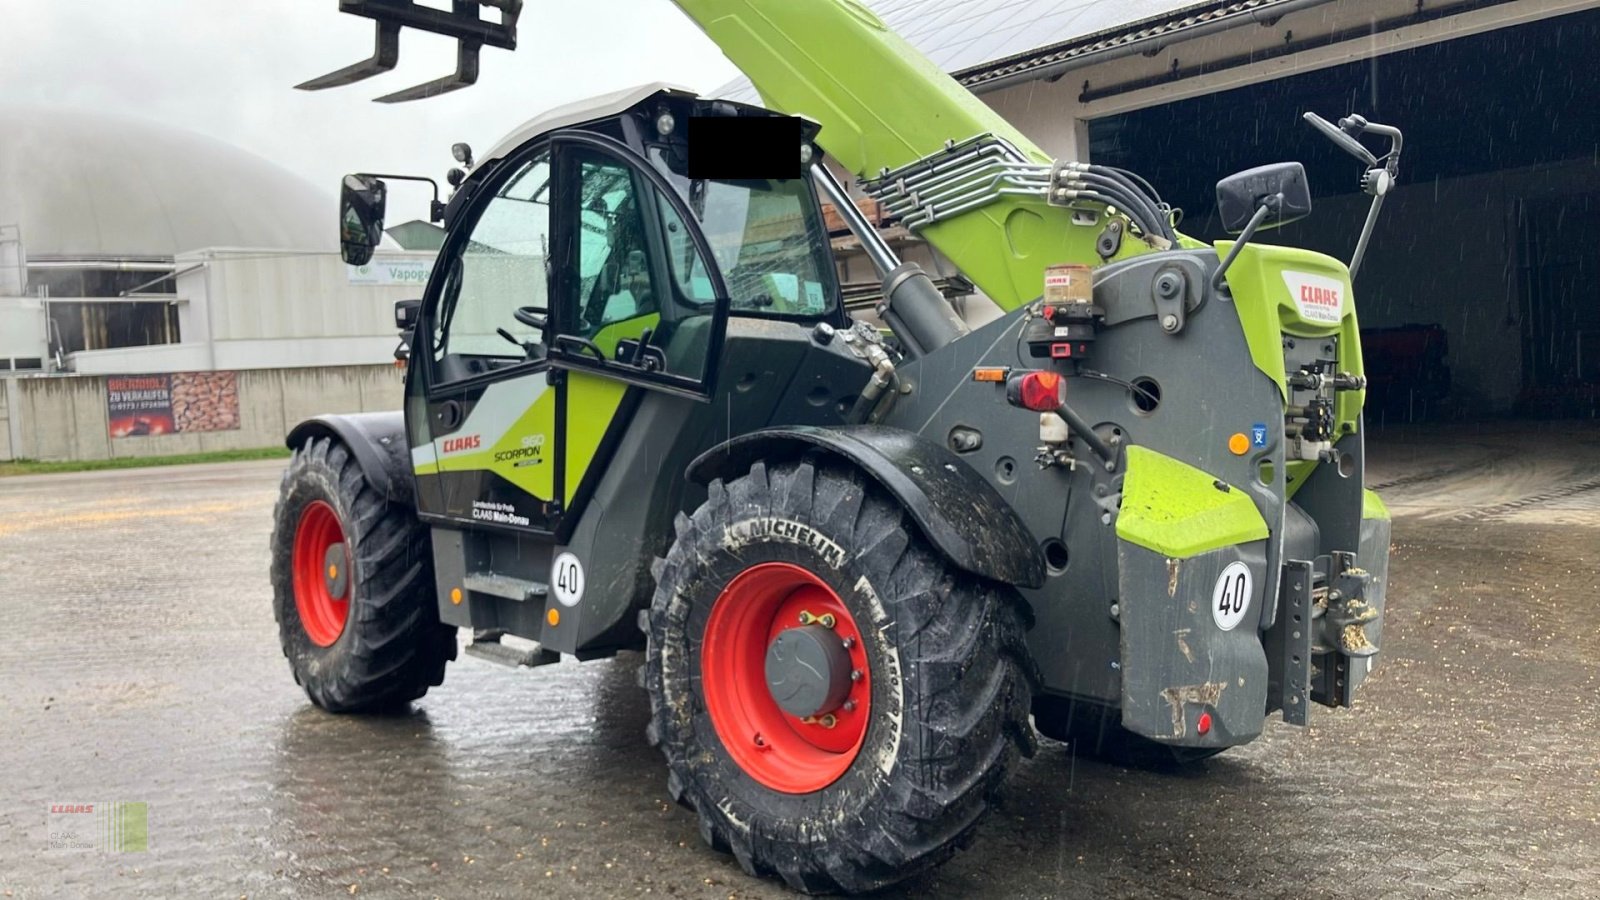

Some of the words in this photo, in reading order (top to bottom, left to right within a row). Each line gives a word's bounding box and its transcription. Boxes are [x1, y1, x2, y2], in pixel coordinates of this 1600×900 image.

[1301, 285, 1338, 307] CLAAS
[110, 391, 121, 402] ZU
[121, 390, 168, 402] VERKAUFEN
[443, 435, 481, 453] CLAAS
[522, 434, 545, 447] 960
[494, 446, 541, 463] SCORPION
[473, 508, 493, 521] CLAAS
[493, 511, 530, 526] Main-Donau
[750, 519, 842, 560] MICHELIN
[558, 562, 577, 594] 40
[1219, 573, 1246, 615] 40
